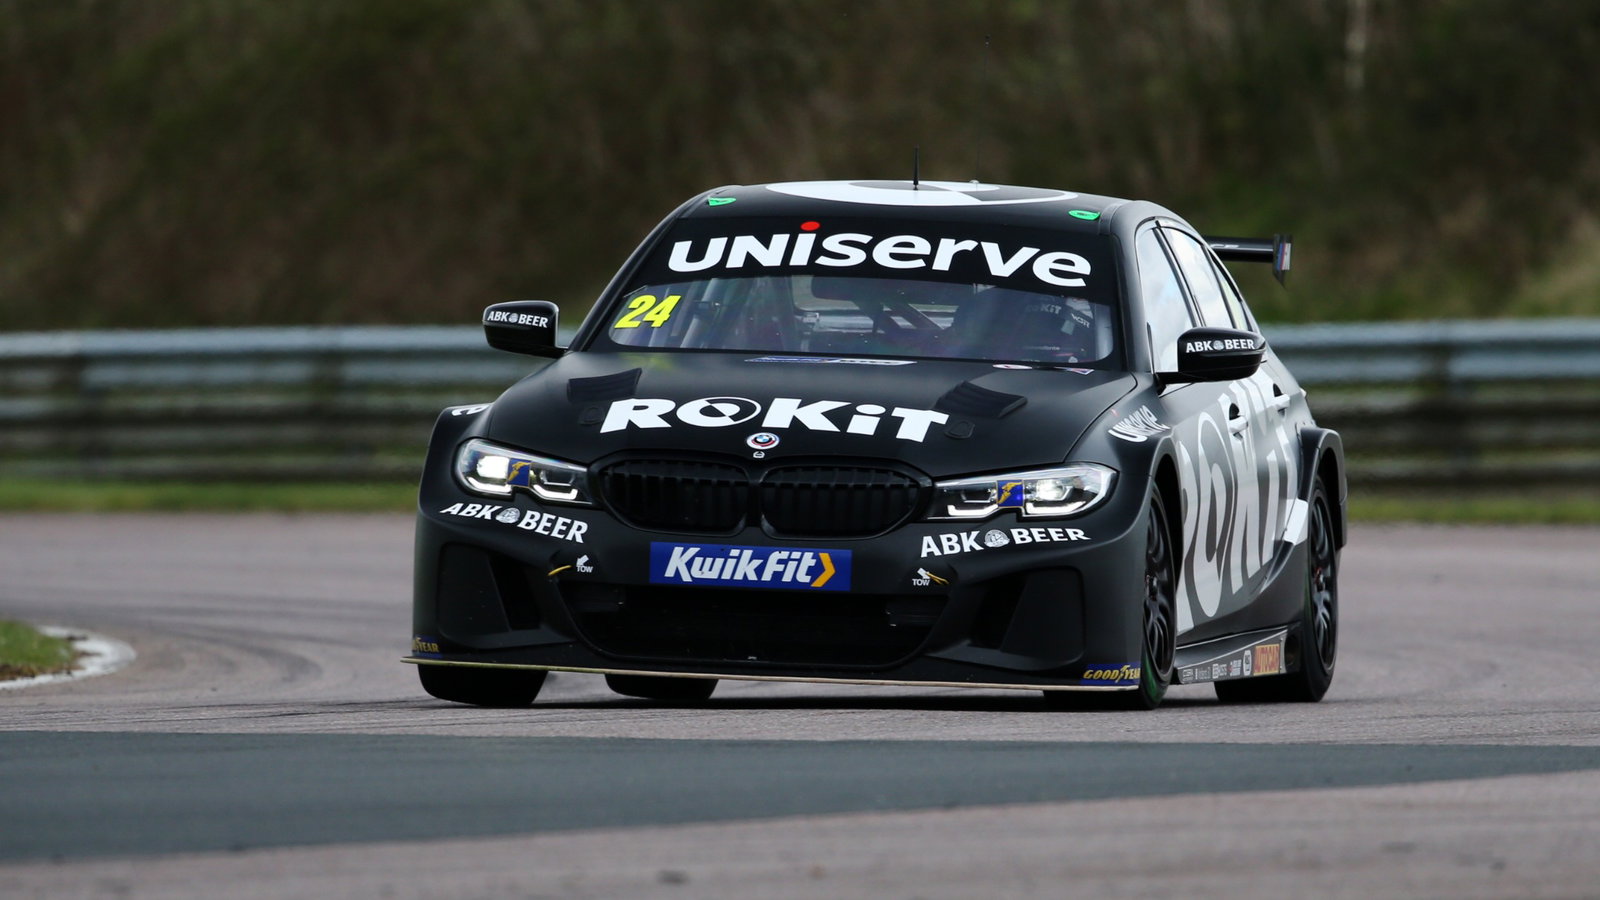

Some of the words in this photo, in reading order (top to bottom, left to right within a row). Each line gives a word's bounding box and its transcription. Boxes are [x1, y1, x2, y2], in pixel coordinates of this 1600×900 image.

[487, 310, 510, 323] ABK
[518, 314, 549, 329] BEER
[614, 295, 681, 329] 24
[1185, 341, 1213, 353] ABK
[1224, 338, 1256, 350] BEER
[439, 502, 502, 520] ABK
[517, 509, 589, 544] BEER
[920, 529, 985, 558] ABK
[1010, 527, 1092, 545] BEER
[576, 565, 594, 573] TOW
[912, 578, 930, 586] TOW
